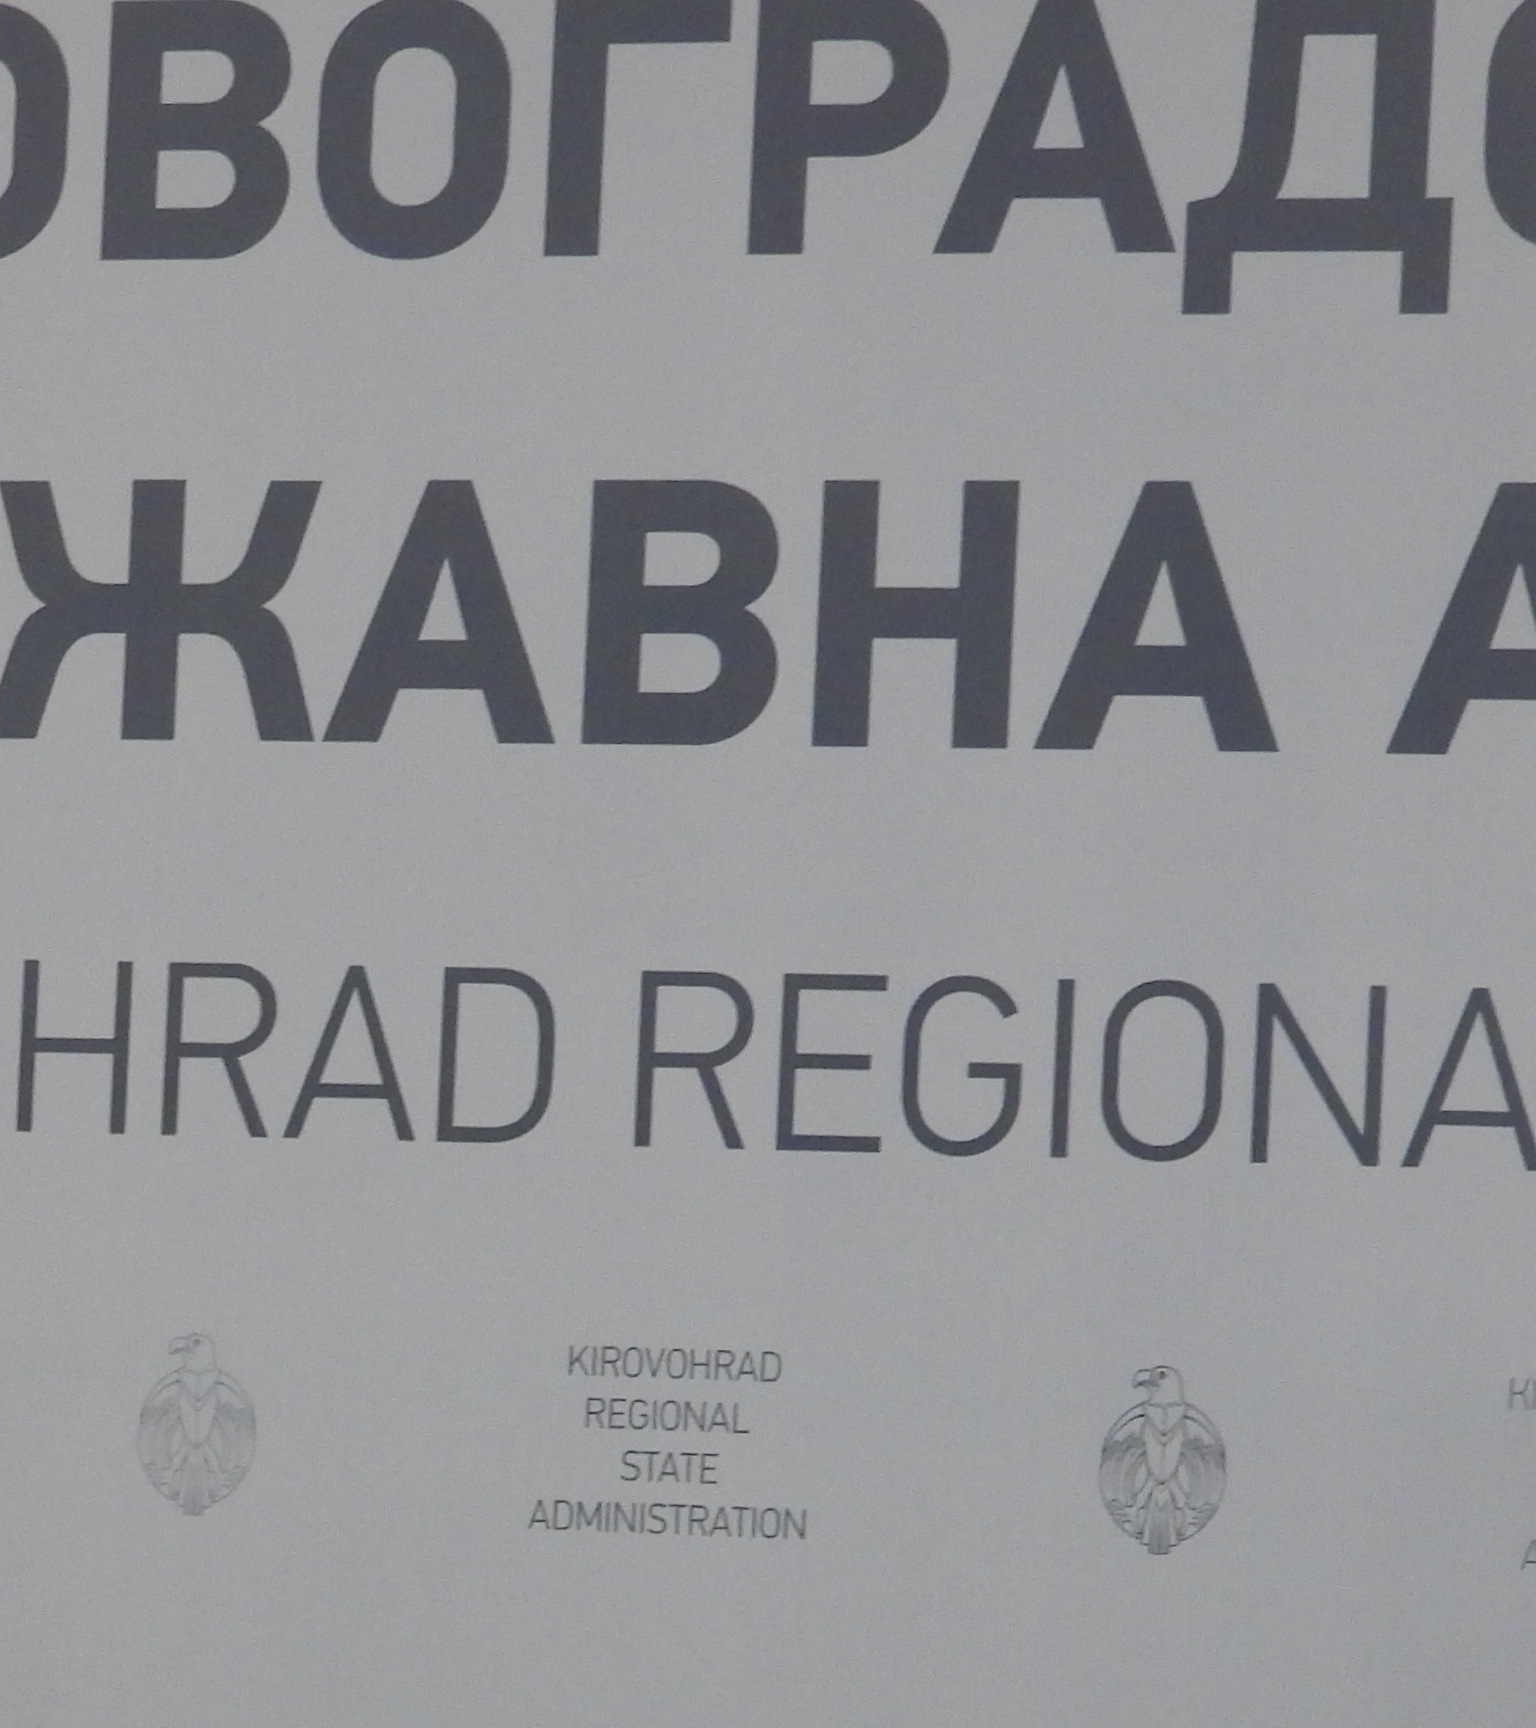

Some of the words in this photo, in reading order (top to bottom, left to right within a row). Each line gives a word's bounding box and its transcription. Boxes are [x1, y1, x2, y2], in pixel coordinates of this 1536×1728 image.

[634, 971, 1536, 1171] REGIONA
[568, 1346, 782, 1382] KIROVOHRAD
[586, 1397, 749, 1434] REGIONAL
[621, 1450, 719, 1484] STATE
[528, 1500, 807, 1539] ADMINISTRATION
